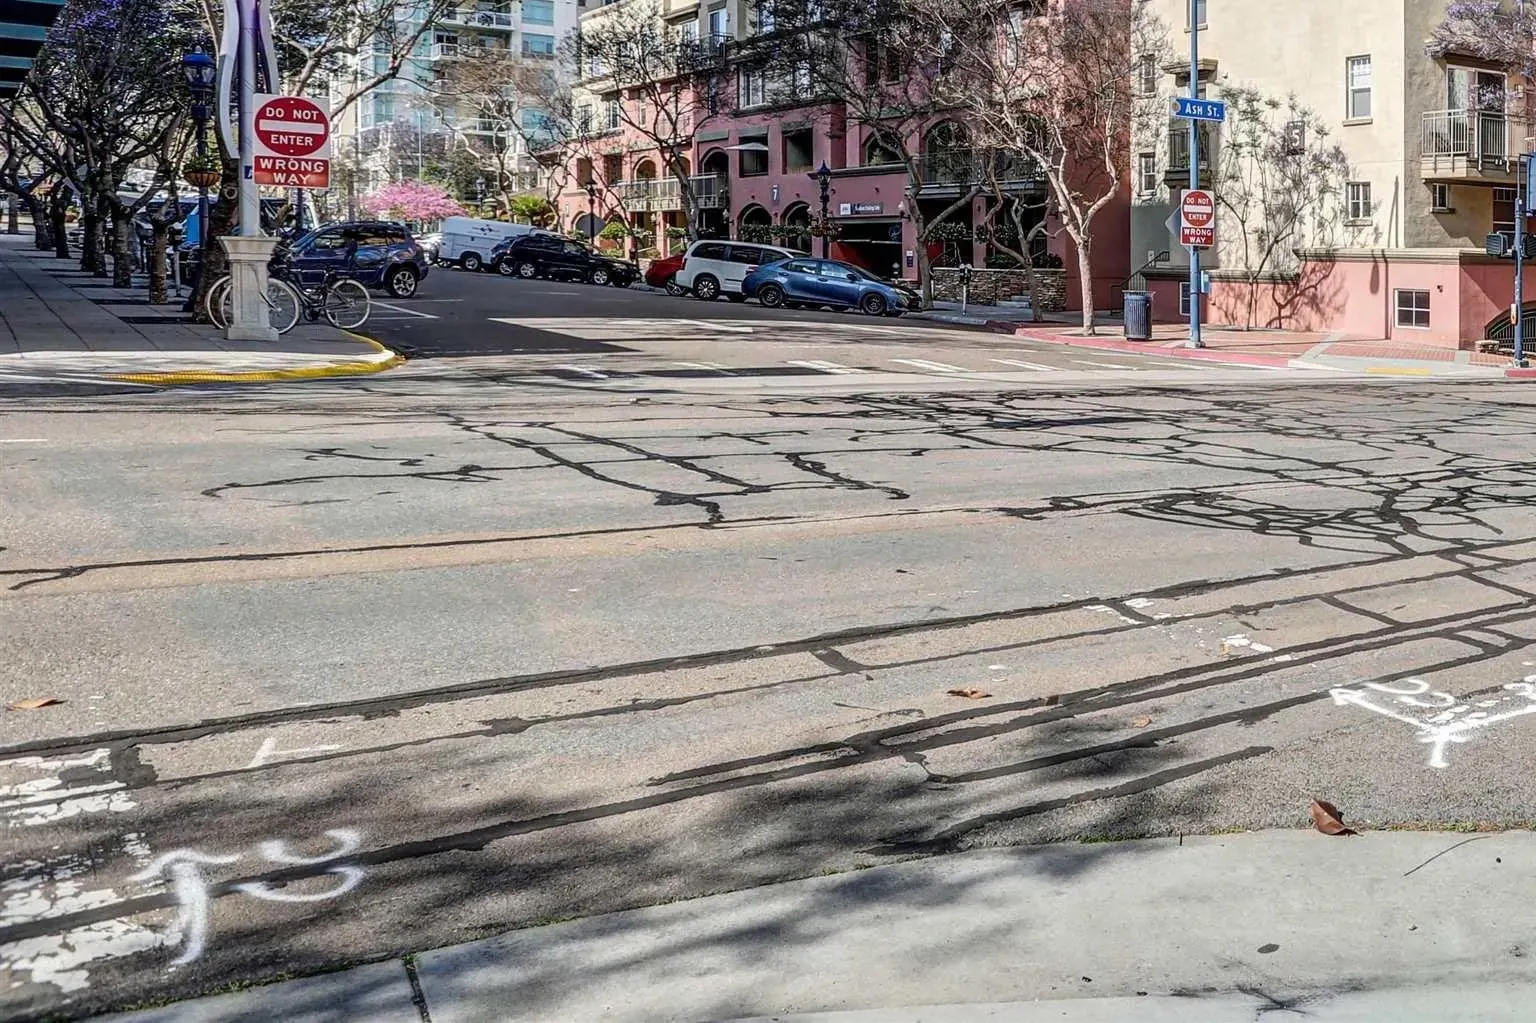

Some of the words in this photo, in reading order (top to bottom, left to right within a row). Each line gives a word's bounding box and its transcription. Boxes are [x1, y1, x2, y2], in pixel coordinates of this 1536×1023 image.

[266, 107, 284, 118] DO
[293, 109, 319, 120] NOT
[1185, 102, 1203, 116] ASH
[271, 134, 313, 146] ENTER
[260, 158, 324, 173] WRONG
[273, 172, 310, 185] WAY
[1183, 228, 1212, 236] WRONG
